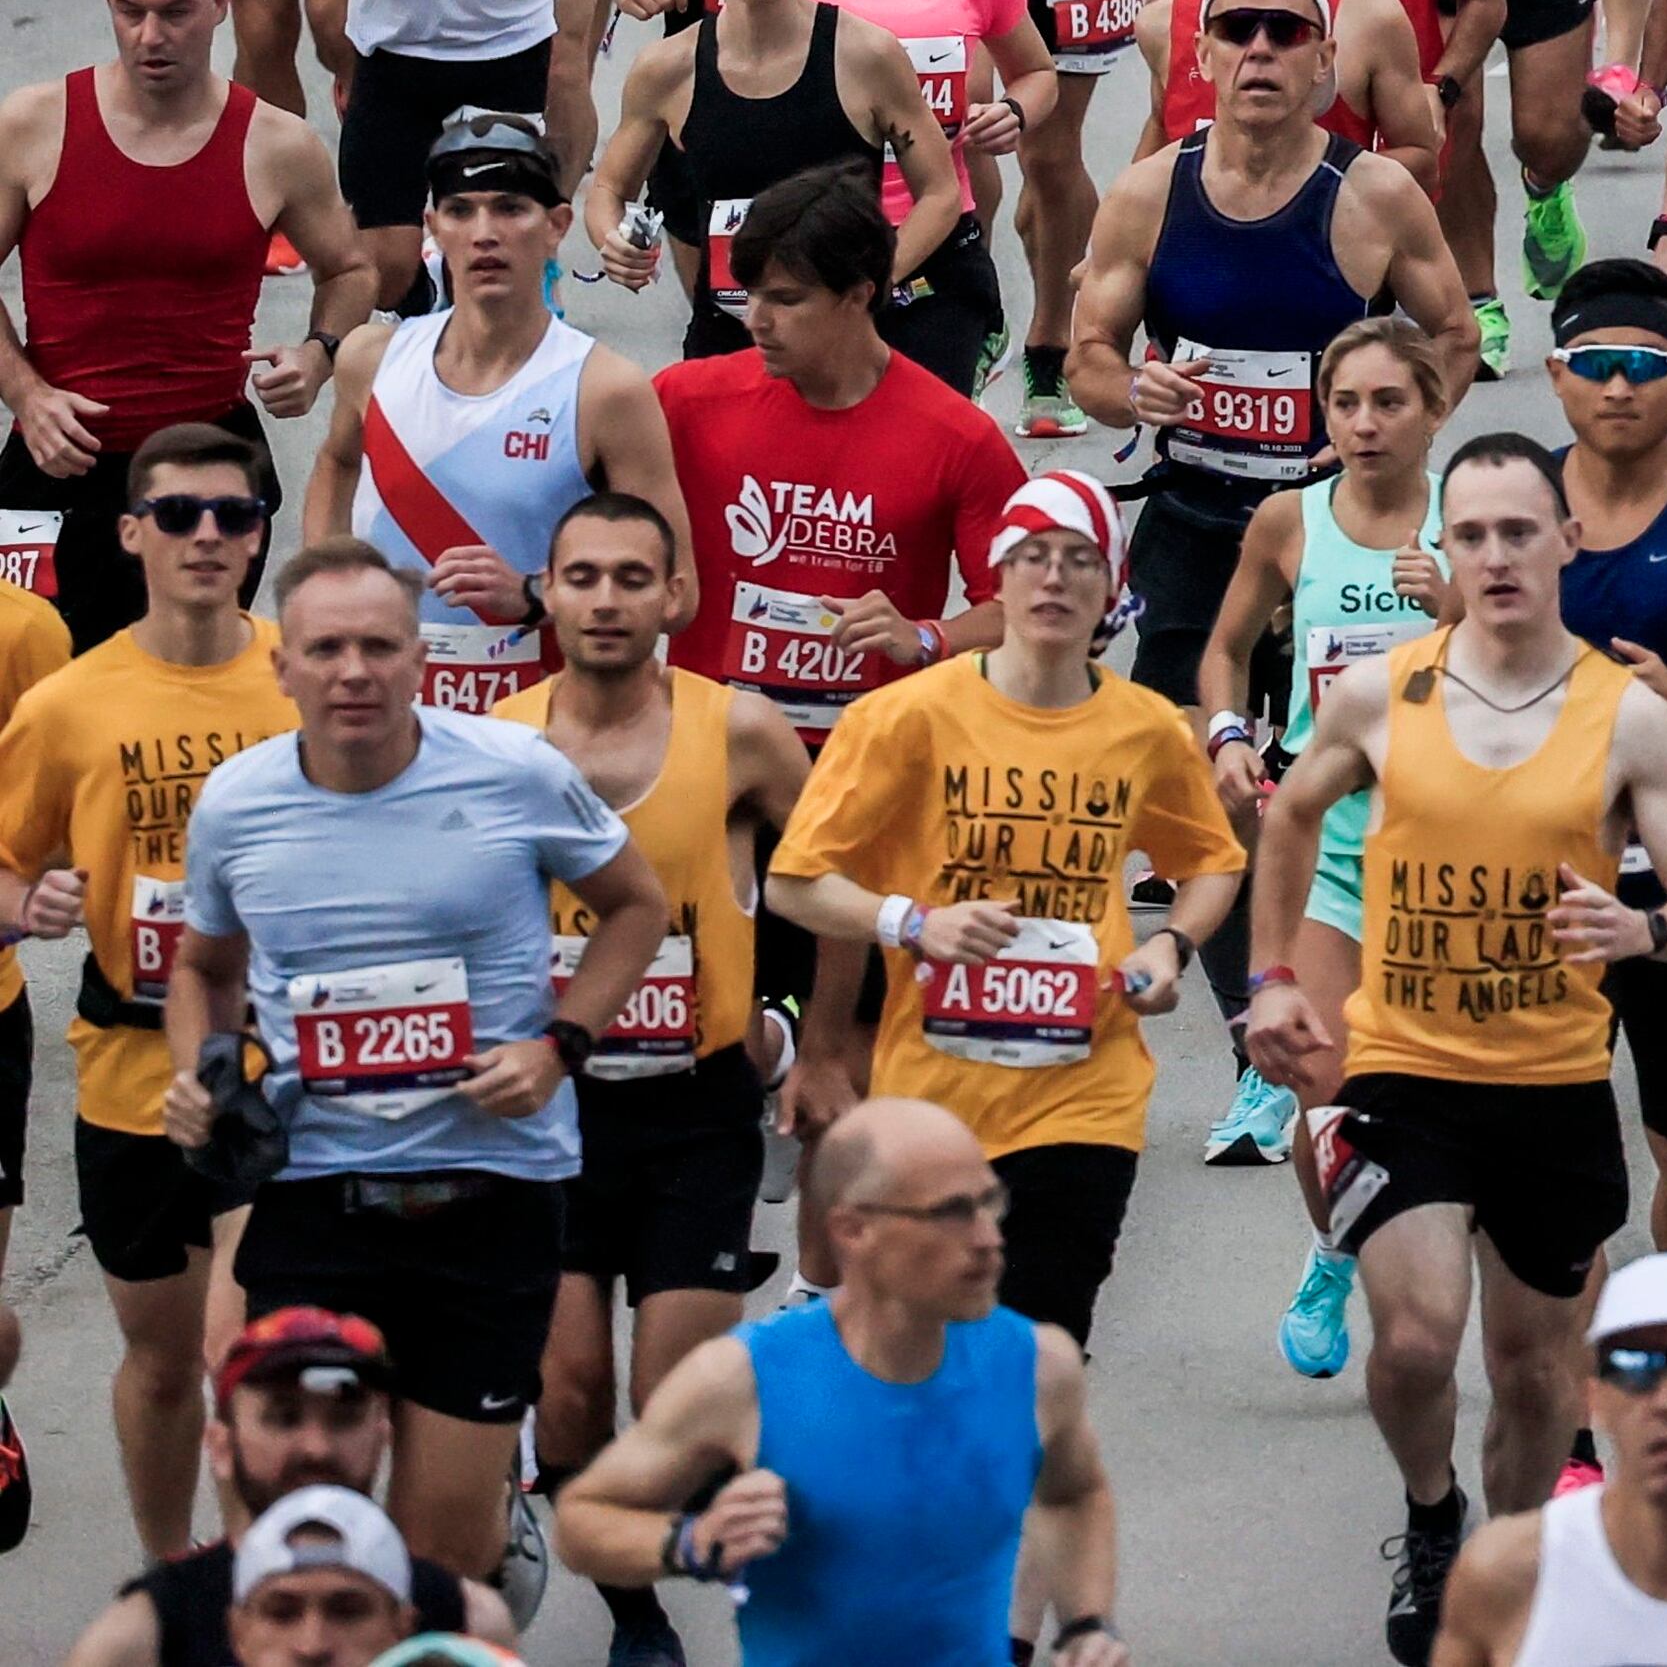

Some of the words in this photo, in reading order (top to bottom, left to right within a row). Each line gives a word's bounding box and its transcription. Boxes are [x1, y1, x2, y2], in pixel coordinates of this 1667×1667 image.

[1071, 9, 1089, 37] B
[1214, 391, 1295, 435] 9319
[504, 431, 549, 461] CHI
[772, 482, 872, 525] TEAM
[790, 517, 896, 555] DEBRA
[742, 632, 764, 672] B
[778, 635, 862, 682] 4202
[433, 672, 517, 712] 6471
[127, 784, 191, 825] OUR
[134, 831, 181, 866] THE
[947, 823, 1012, 861] OUR
[1041, 825, 1112, 879] LAD
[136, 929, 160, 970] B
[1386, 920, 1449, 960] OUR
[1477, 923, 1558, 968] LAD
[942, 970, 969, 1010] A
[982, 969, 1078, 1016] 5062
[1384, 973, 1434, 1013] THE
[1456, 970, 1568, 1023] ANGELS
[318, 1022, 345, 1067] B
[356, 1013, 454, 1064] 2265
